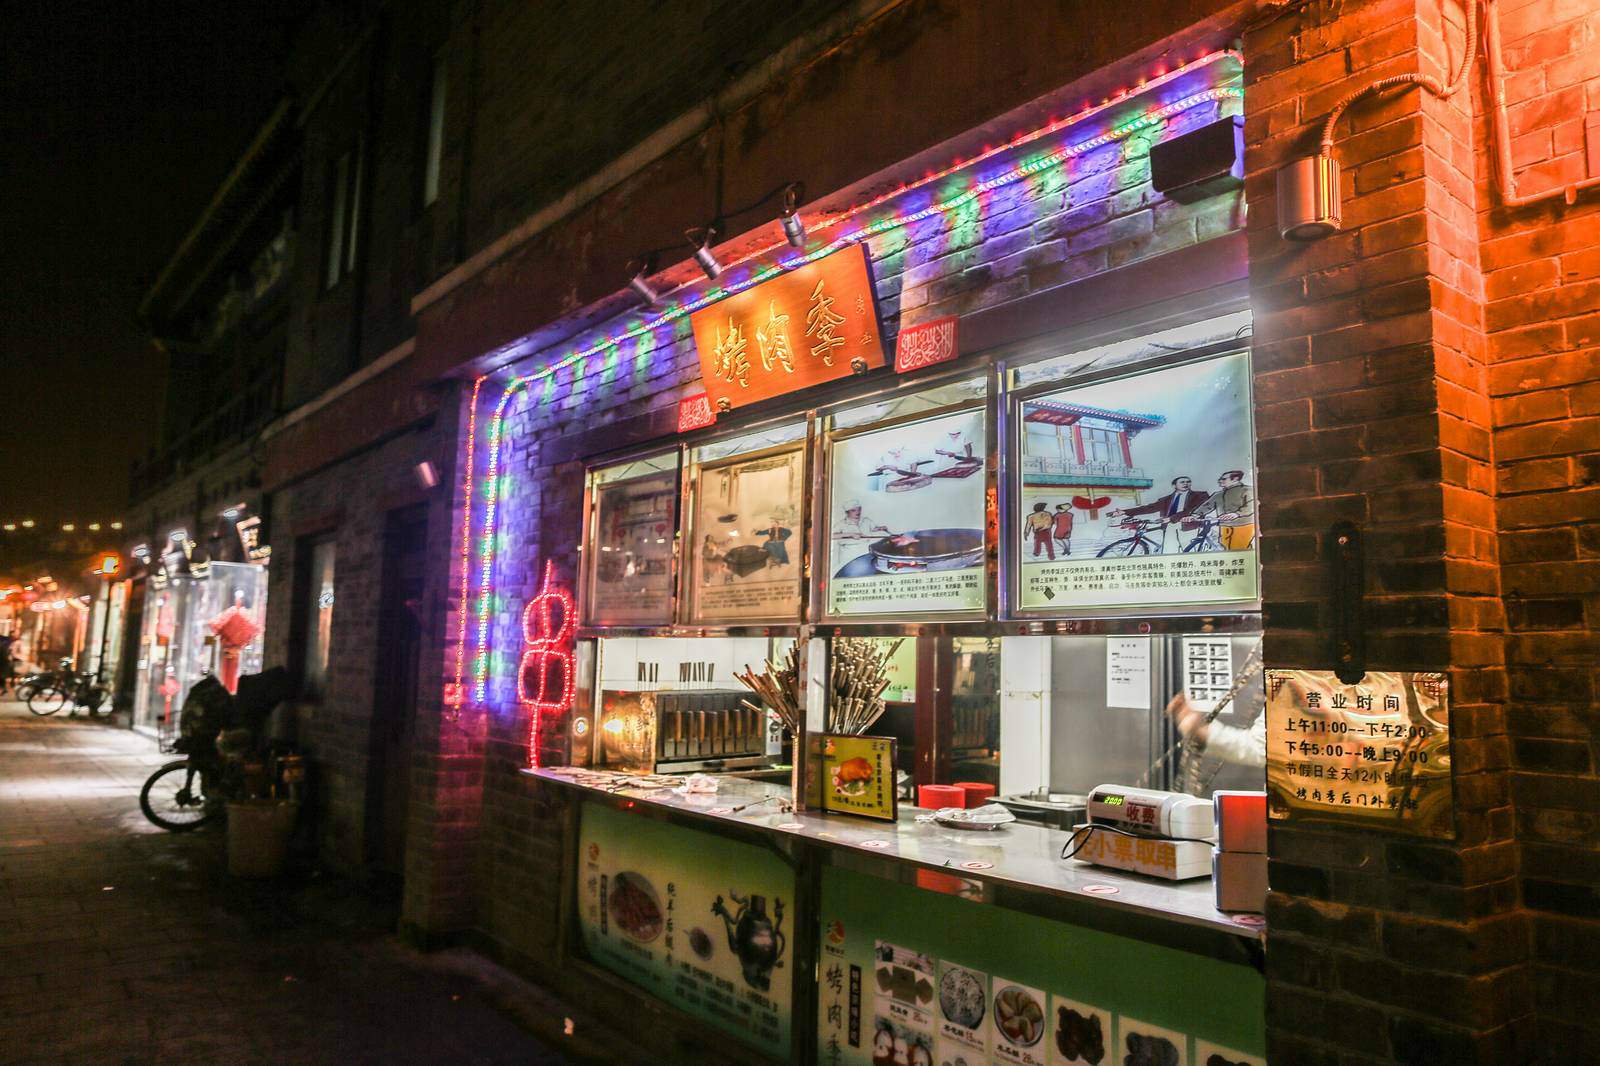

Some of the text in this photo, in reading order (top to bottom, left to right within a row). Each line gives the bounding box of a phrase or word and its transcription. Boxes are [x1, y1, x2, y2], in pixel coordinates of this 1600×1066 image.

[714, 279, 847, 388] 烤肉季
[1306, 692, 1400, 712] 营业时间
[1126, 805, 1155, 824] 收费
